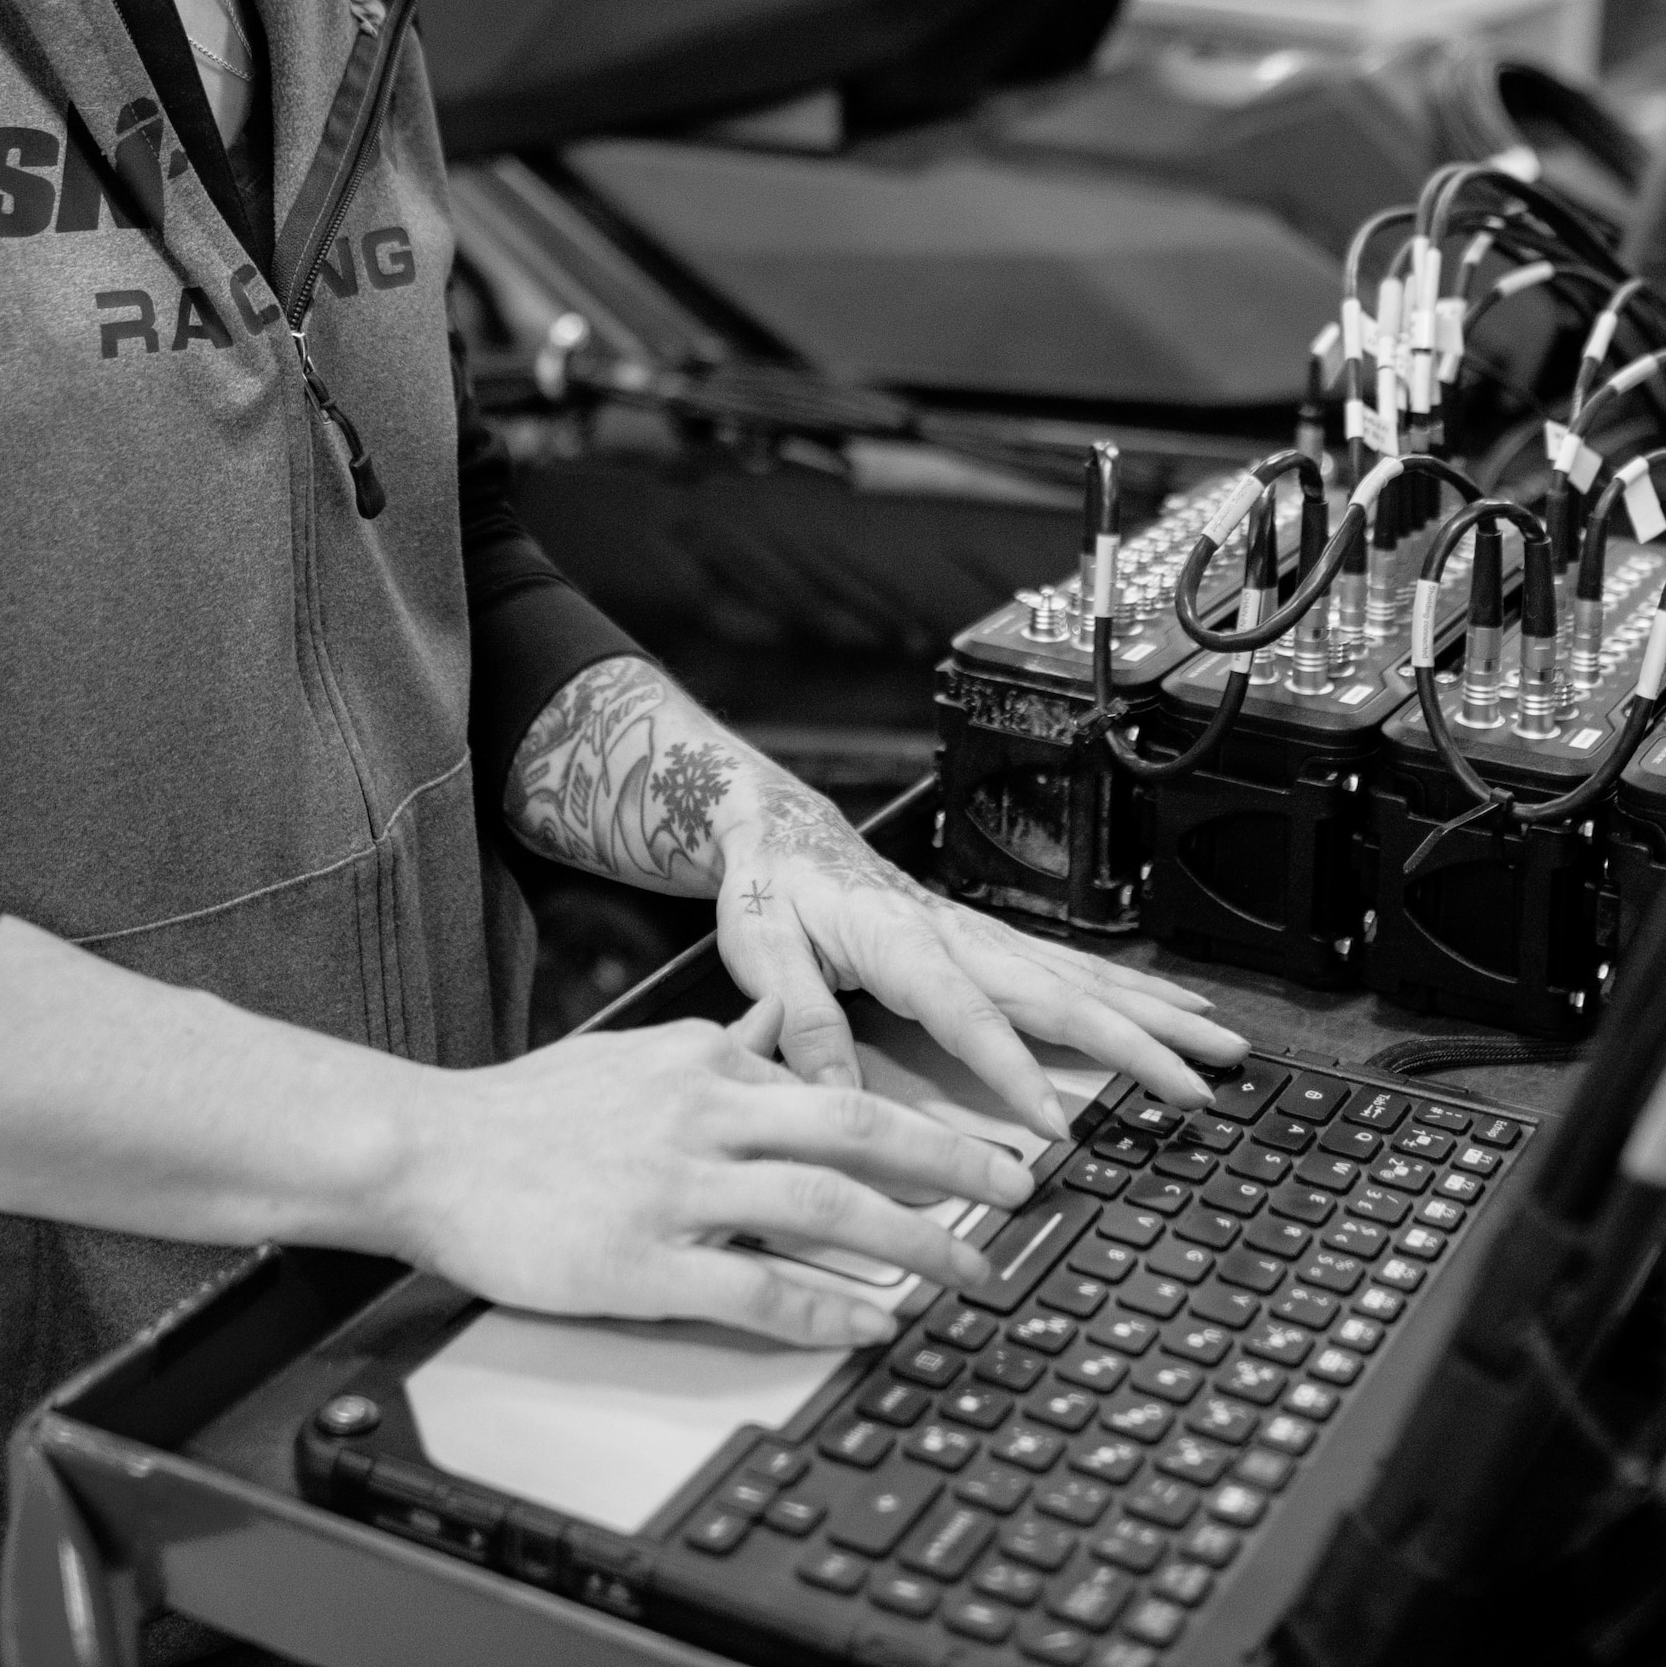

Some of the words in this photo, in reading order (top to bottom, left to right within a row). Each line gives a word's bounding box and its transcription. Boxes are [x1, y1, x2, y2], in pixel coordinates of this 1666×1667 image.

[95, 226, 416, 359] RACNG
[1371, 1093, 1391, 1107] Tab
[1215, 1124, 1233, 1134] Z
[1288, 1123, 1305, 1134] A
[1354, 1131, 1374, 1143] Q
[1190, 1152, 1209, 1164] X
[1264, 1154, 1282, 1164] S
[1332, 1162, 1353, 1176] W
[1165, 1185, 1181, 1195] C
[1240, 1184, 1258, 1196] D
[1309, 1193, 1327, 1205] E
[1137, 1216, 1155, 1227] V
[1216, 1217, 1232, 1228] F
